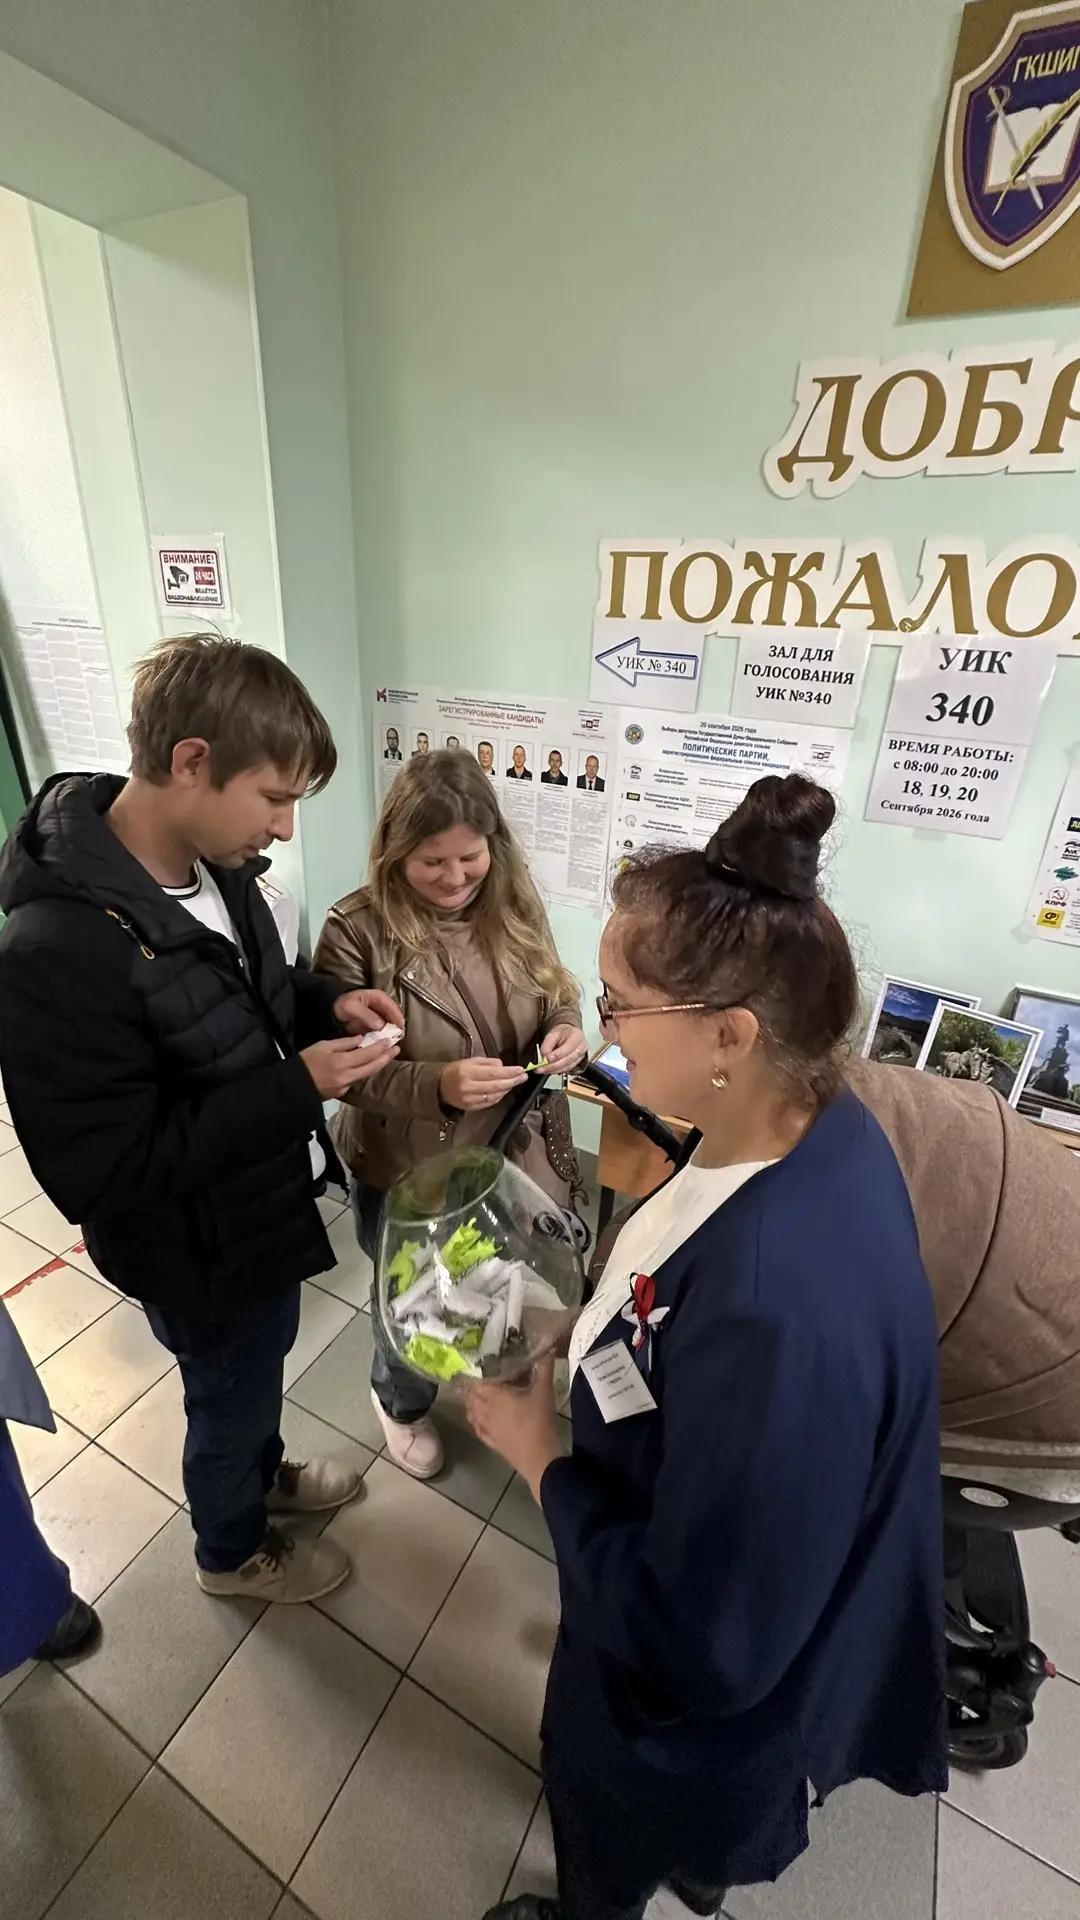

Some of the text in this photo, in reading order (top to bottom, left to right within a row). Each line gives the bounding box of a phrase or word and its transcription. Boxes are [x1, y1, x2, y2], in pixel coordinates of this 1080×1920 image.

[163, 554, 215, 564] ВНИМАНИЕ!
[605, 550, 1080, 640] ПОЖАЛО
[768, 645, 834, 662] ЗАЛ ДЛЯ
[938, 647, 1013, 675] УИК
[616, 656, 687, 674] УИК № 340
[743, 663, 855, 685] ГОЛОСОВАНИЯ
[755, 686, 832, 705] УИК №340
[506, 713, 544, 724] КАНДИДАТЫ
[925, 691, 994, 726] 340
[682, 742, 770, 761] ПОЛИТИЧЕСКИЕ ПАРТИИ,
[888, 739, 1014, 763] ВРЕМЯ РАБОТЫ:
[893, 759, 999, 781] с 08:00 до 20:00
[901, 780, 979, 802] 18, 19, 20
[880, 799, 990, 823] Сентября 2026 года
[1045, 899, 1067, 907] КПРФ
